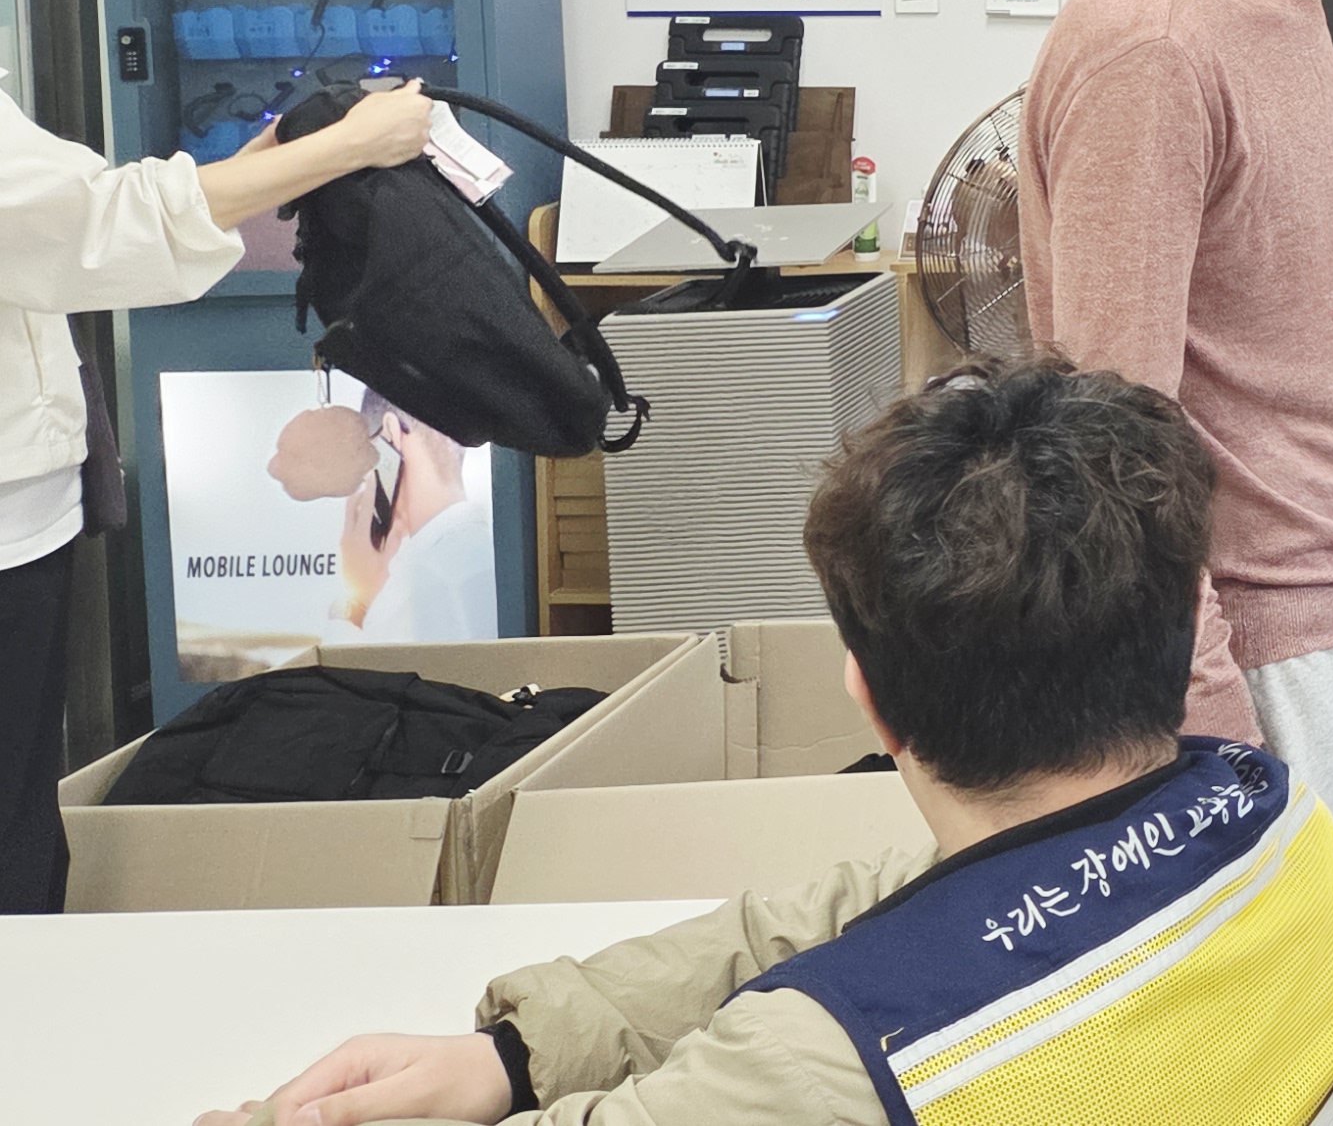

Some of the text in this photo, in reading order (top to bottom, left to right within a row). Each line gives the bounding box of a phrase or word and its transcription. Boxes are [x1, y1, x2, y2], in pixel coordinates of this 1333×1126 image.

[187, 553, 336, 578] MOBILE LOUNGE
[982, 885, 1080, 951] 우리는
[1071, 813, 1185, 897] 장애인
